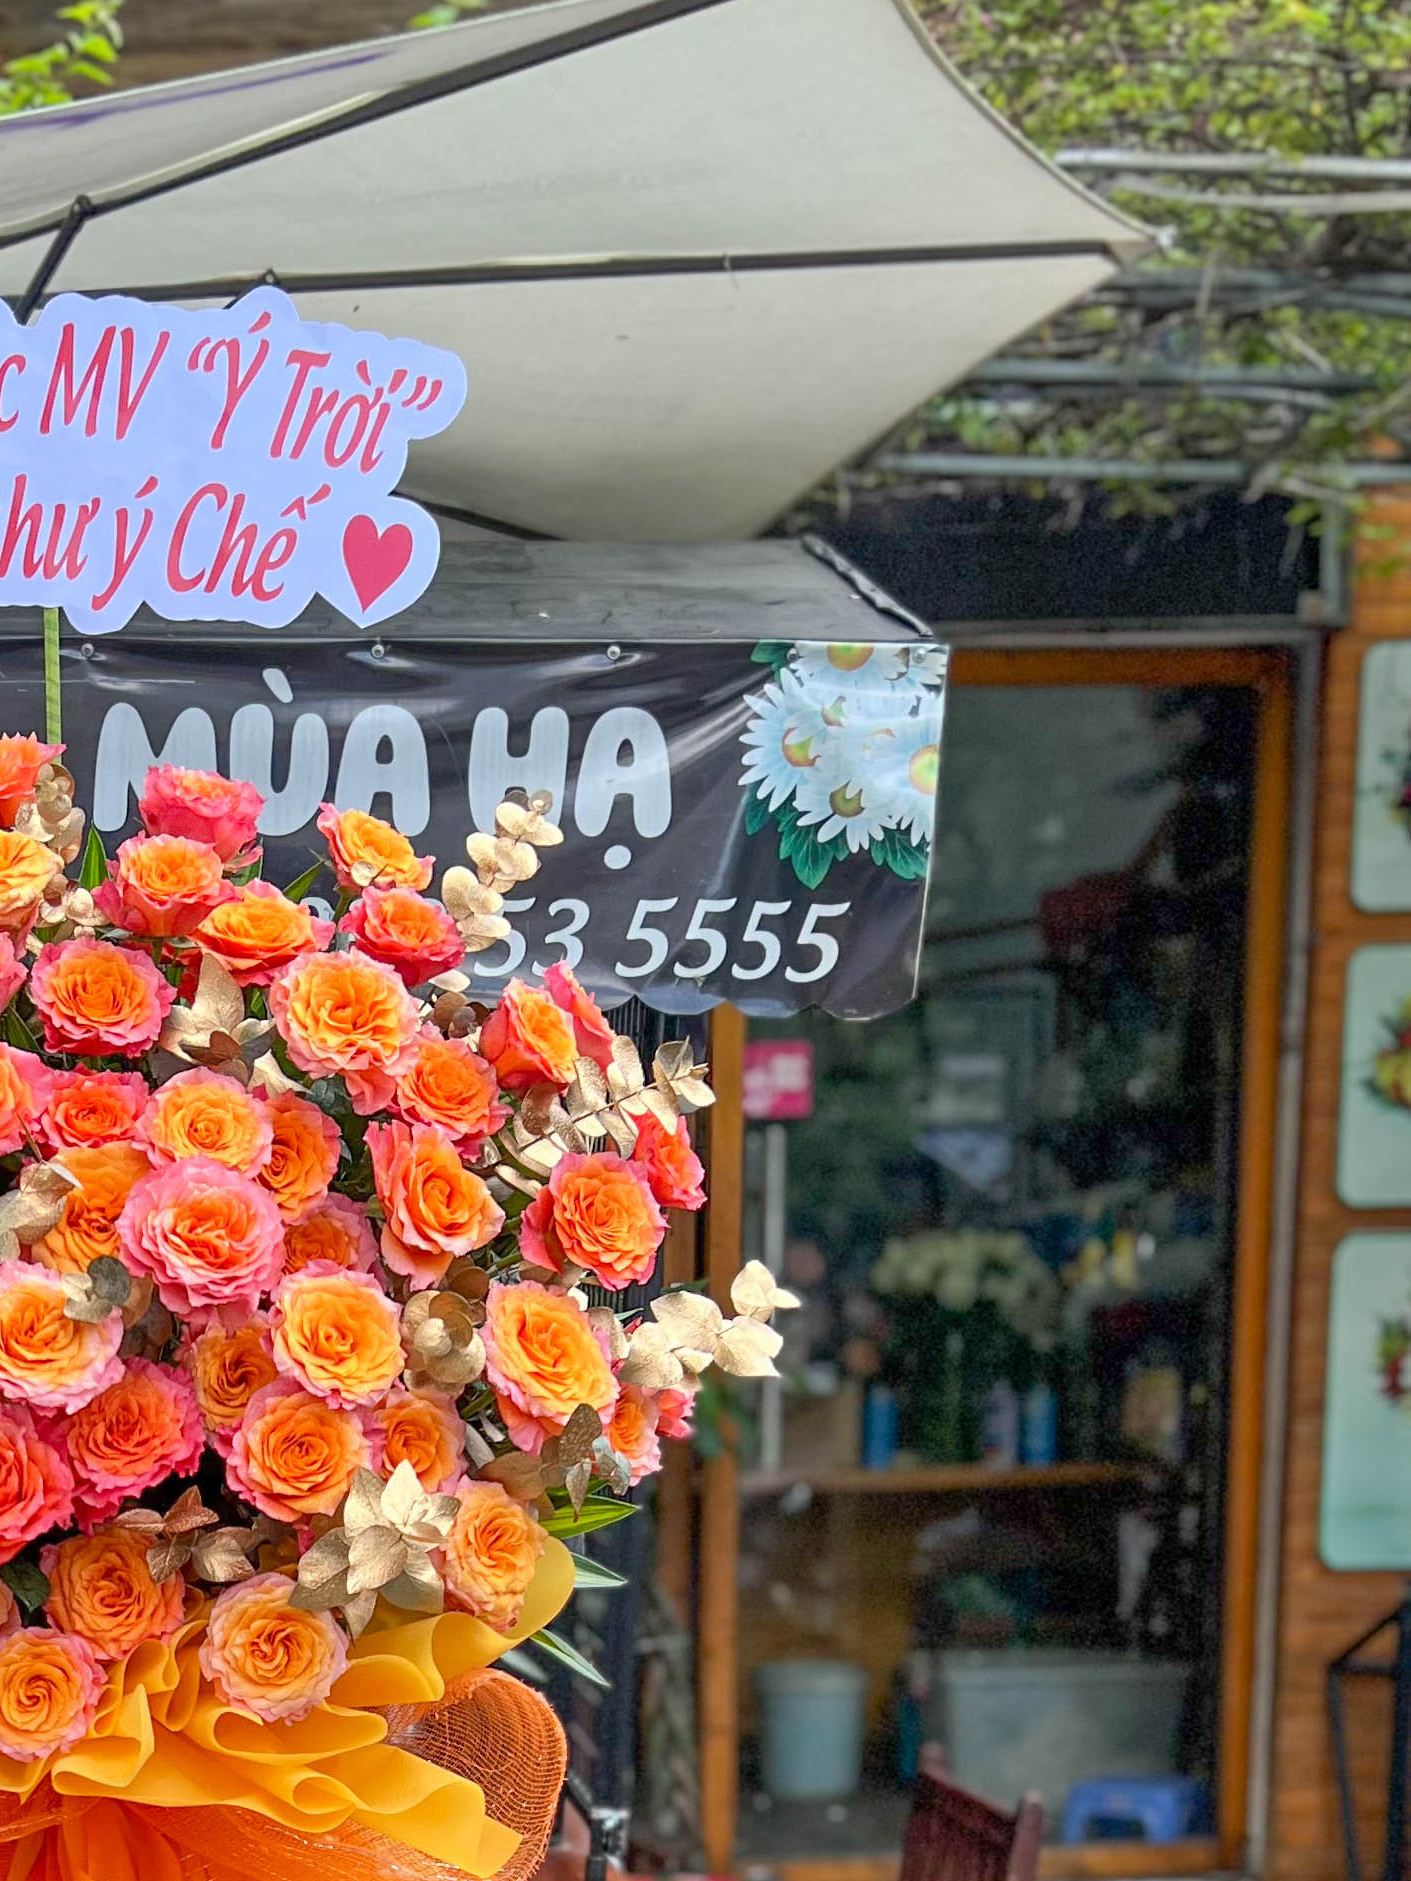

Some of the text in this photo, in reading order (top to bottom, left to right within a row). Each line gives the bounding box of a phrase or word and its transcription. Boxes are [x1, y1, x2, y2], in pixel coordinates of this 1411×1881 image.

[40, 322, 170, 441] MV
[92, 475, 159, 611] ý
[166, 483, 331, 602] Chế
[93, 667, 431, 837] MÙA
[468, 705, 674, 870] HẠ
[615, 896, 851, 983] 5555
